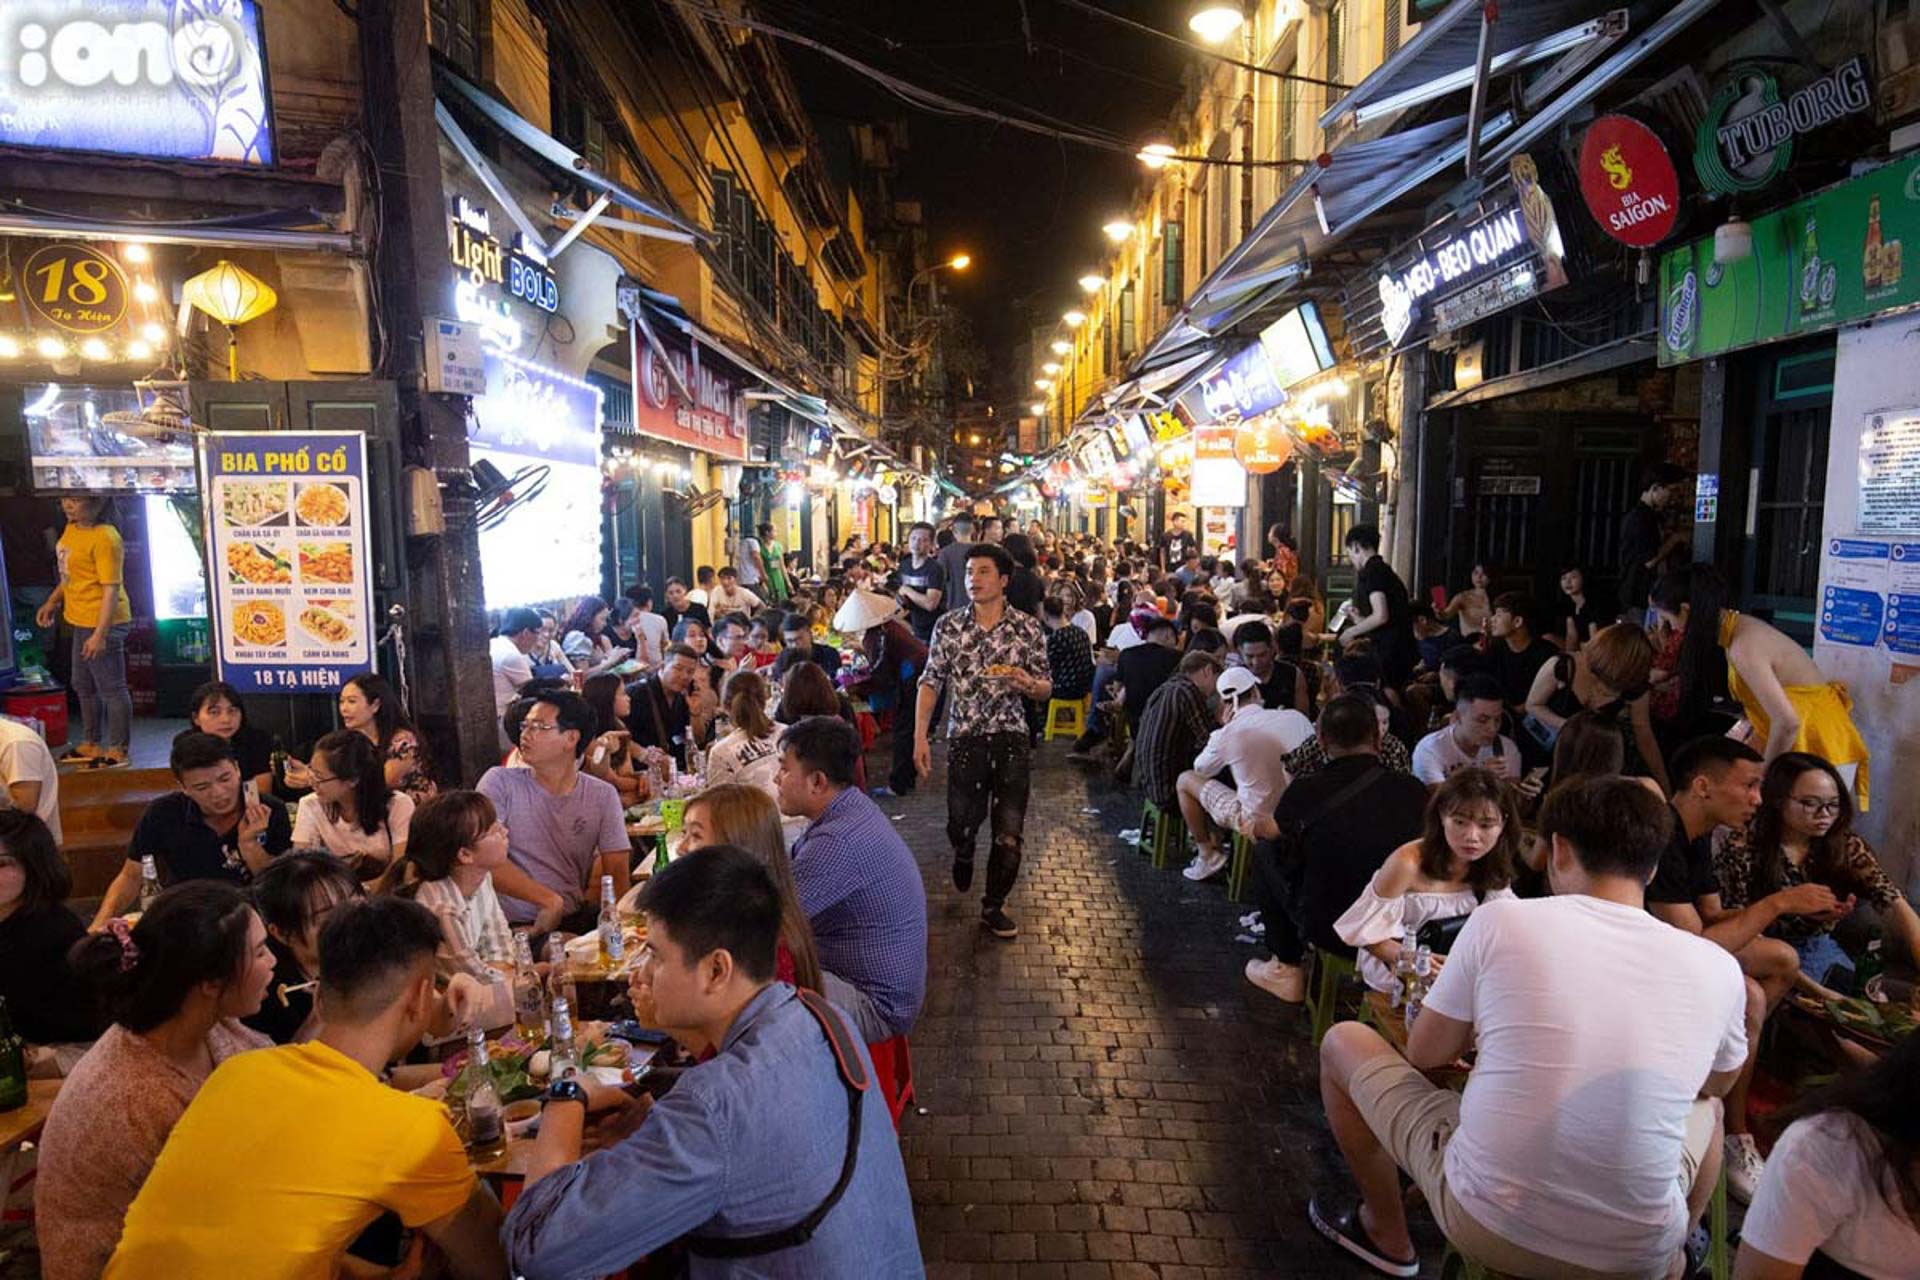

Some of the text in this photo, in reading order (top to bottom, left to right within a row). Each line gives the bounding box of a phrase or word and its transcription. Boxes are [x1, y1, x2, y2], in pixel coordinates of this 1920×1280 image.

[1716, 57, 1870, 169] TUBORG
[1609, 194, 1668, 231] SAIGON
[1621, 191, 1641, 207] BIA
[36, 257, 109, 305] 18
[452, 226, 504, 288] Light
[511, 257, 559, 313] BOLD
[1667, 271, 1697, 351] TUBORG
[221, 444, 347, 473] BIA PHỐ CỔ
[253, 667, 340, 688] 18 TẠ HIỆN
